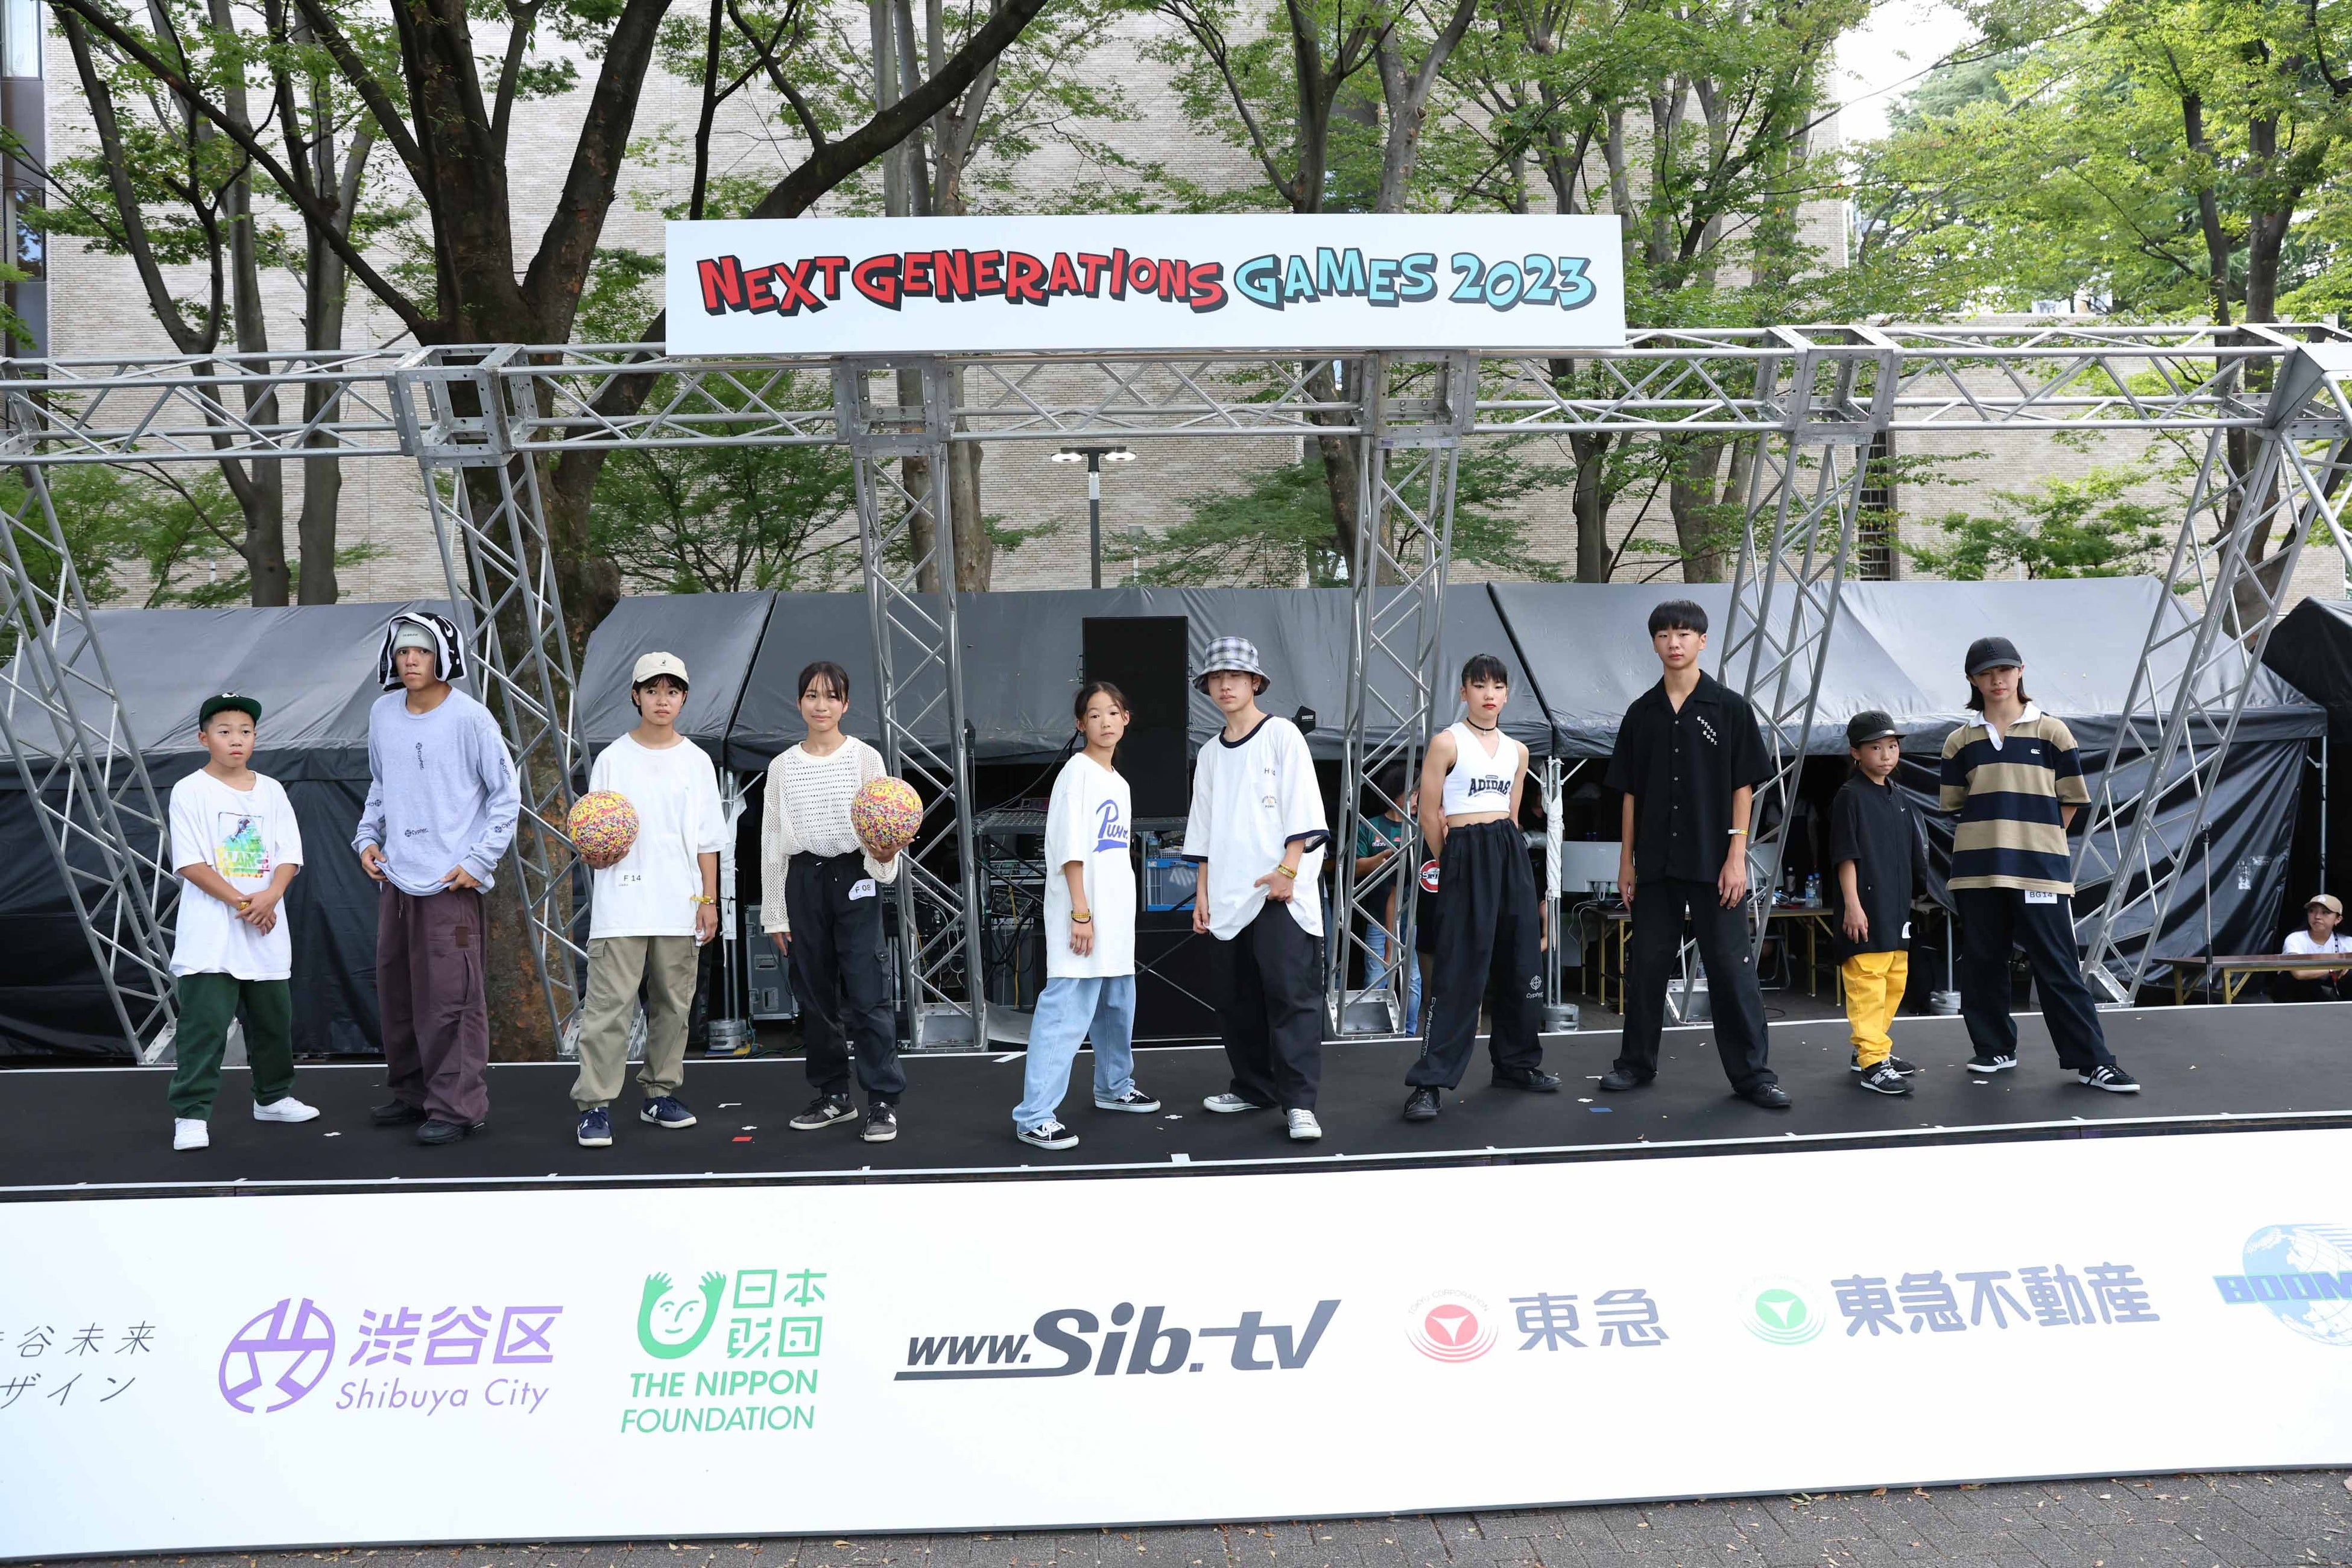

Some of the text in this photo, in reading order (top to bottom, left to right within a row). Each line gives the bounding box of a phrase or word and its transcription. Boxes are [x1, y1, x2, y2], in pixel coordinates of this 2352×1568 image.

[851, 248, 1228, 314] GENERATIONS
[1234, 247, 1438, 311] GAMES
[1448, 252, 1597, 312] 2023
[1468, 778, 1511, 797] ADIDAS
[733, 1268, 827, 1309] 日本
[1830, 1262, 2160, 1337] 東急不動産
[0, 1320, 156, 1358] 谷未来
[349, 1306, 563, 1367] 渋谷区
[1509, 1289, 1669, 1351] 東急
[336, 1377, 549, 1417] Shibuya City
[630, 1369, 818, 1398] THE NIPPON
[621, 1405, 815, 1434] FOUNDATION
